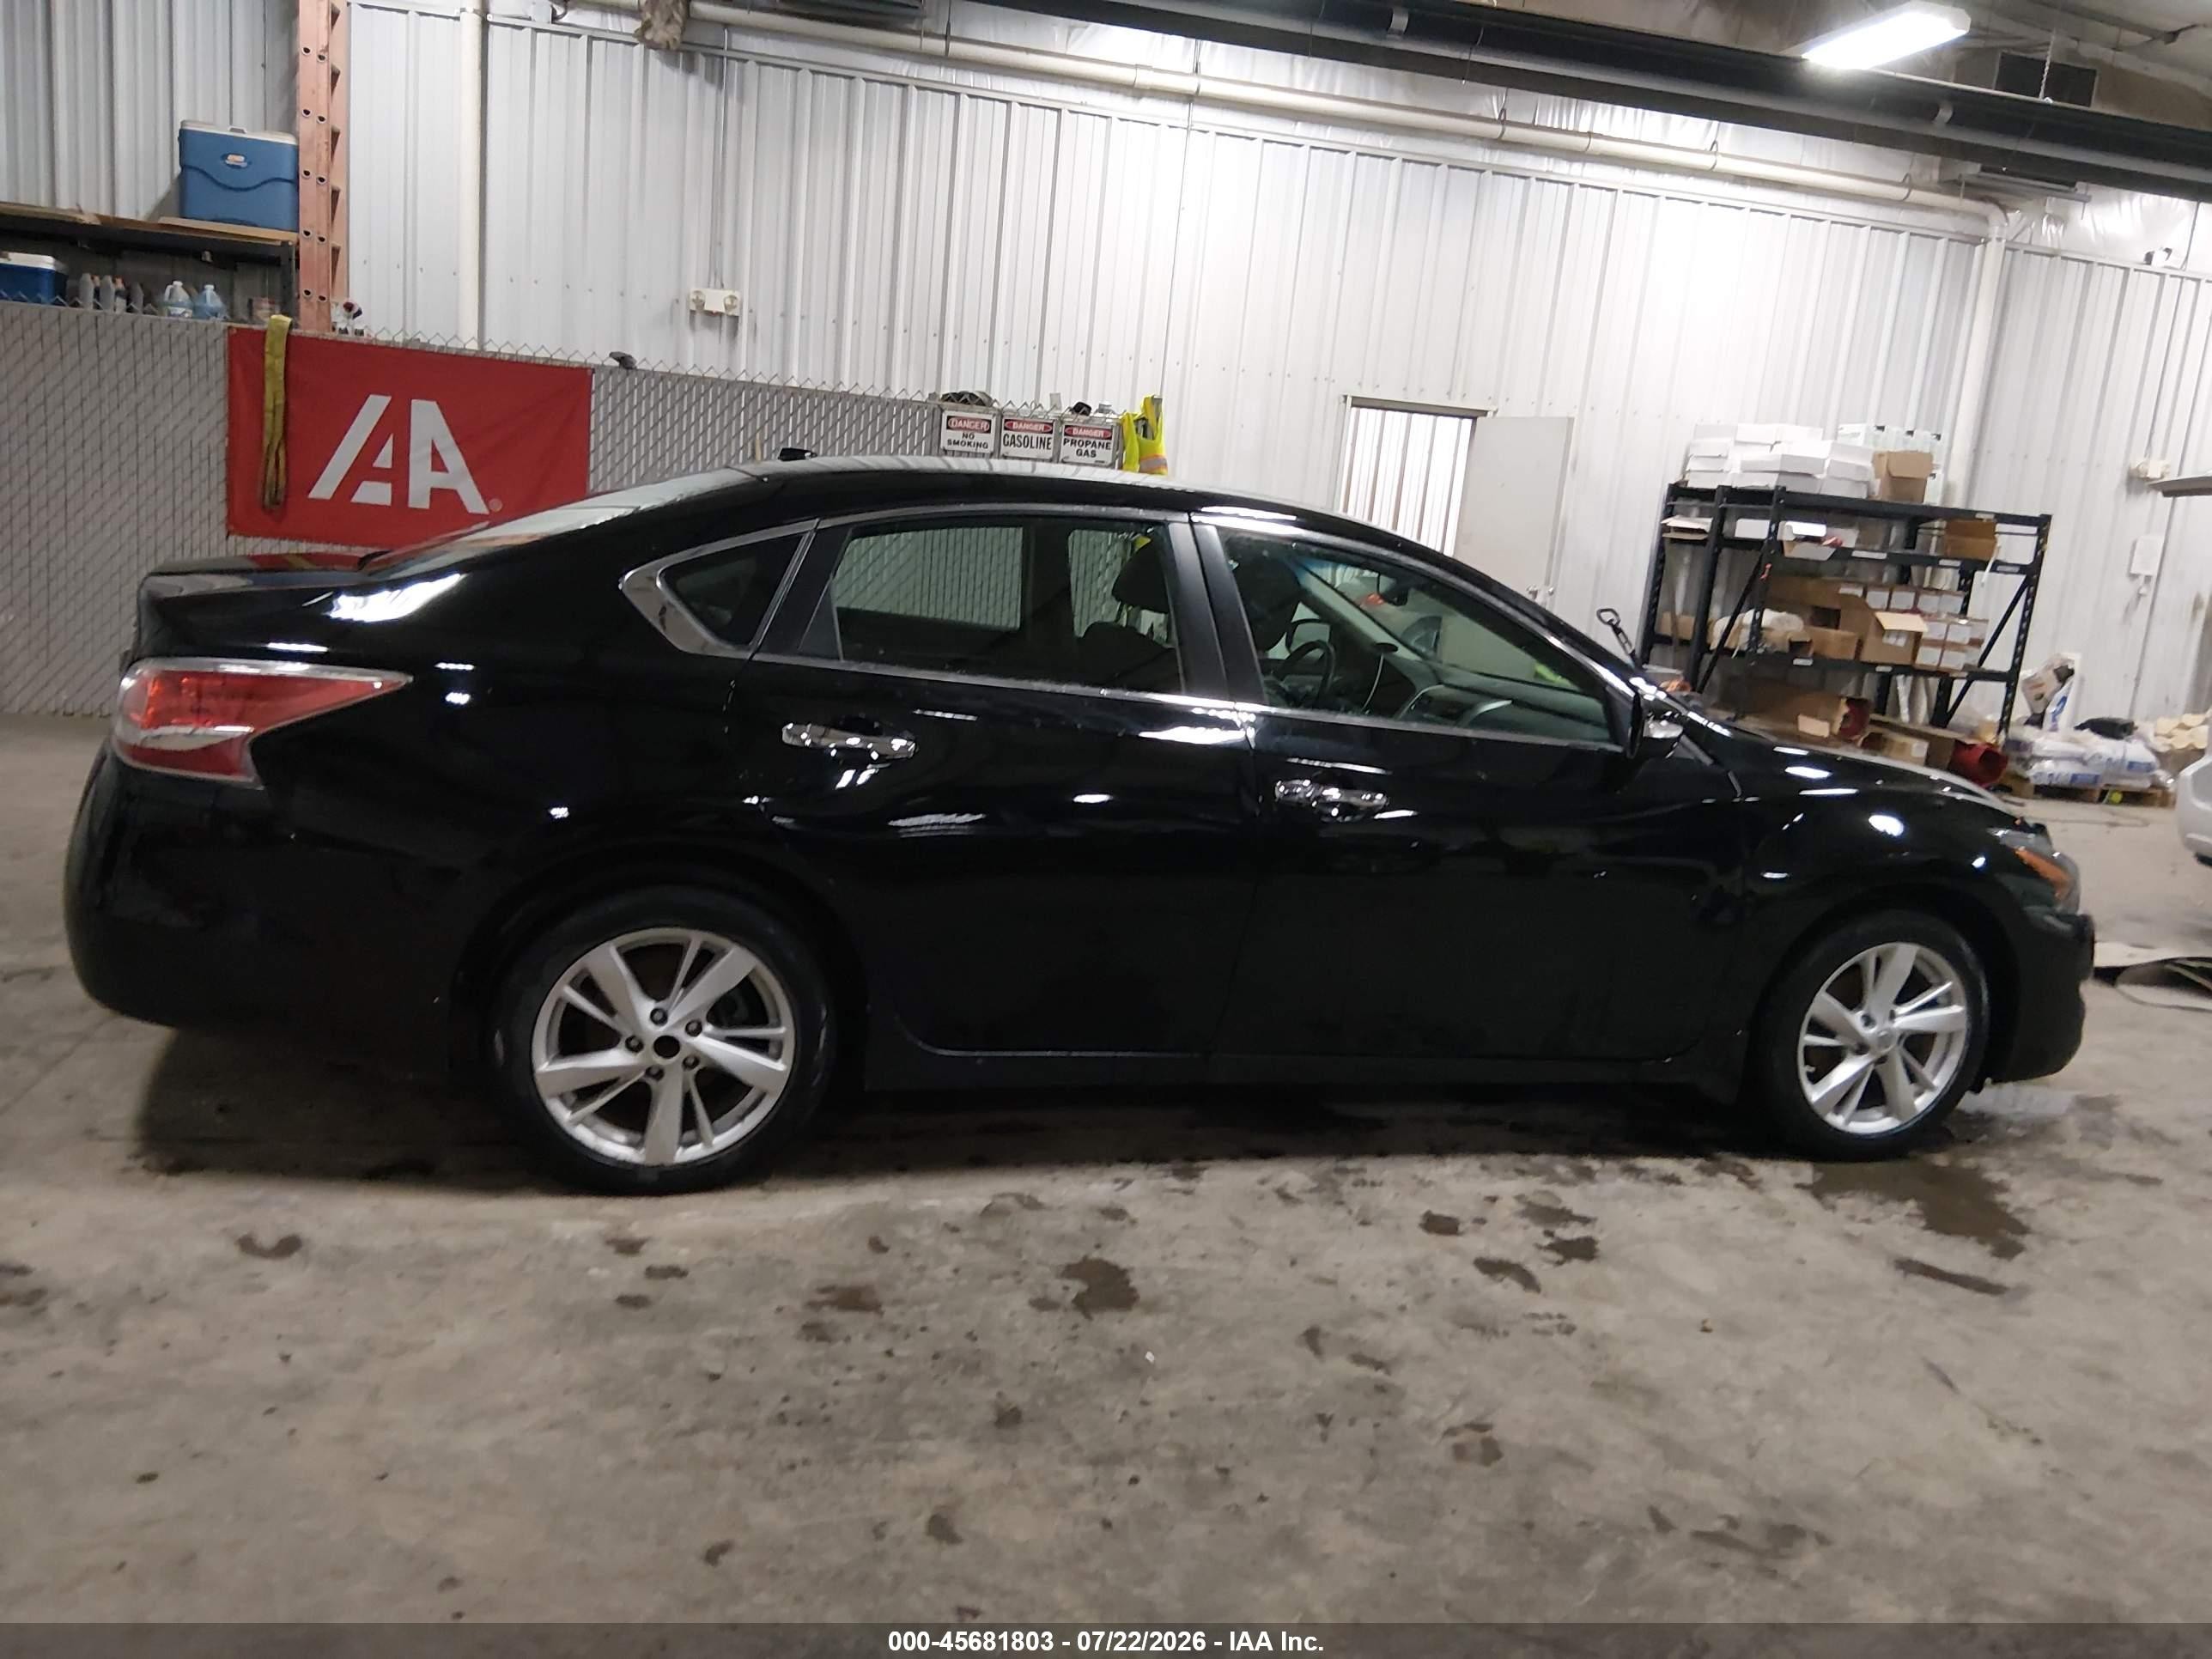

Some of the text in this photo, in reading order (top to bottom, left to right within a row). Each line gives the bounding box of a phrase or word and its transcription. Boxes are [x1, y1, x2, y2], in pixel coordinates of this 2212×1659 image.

[951, 418, 988, 431] DANGER
[1012, 421, 1045, 432] DANGER
[1073, 427, 1104, 438] DANGER
[947, 439, 988, 449] SMOKING
[1003, 433, 1052, 451] GASOLINE
[1063, 437, 1111, 450] PROPANE
[1075, 447, 1097, 459] GAS
